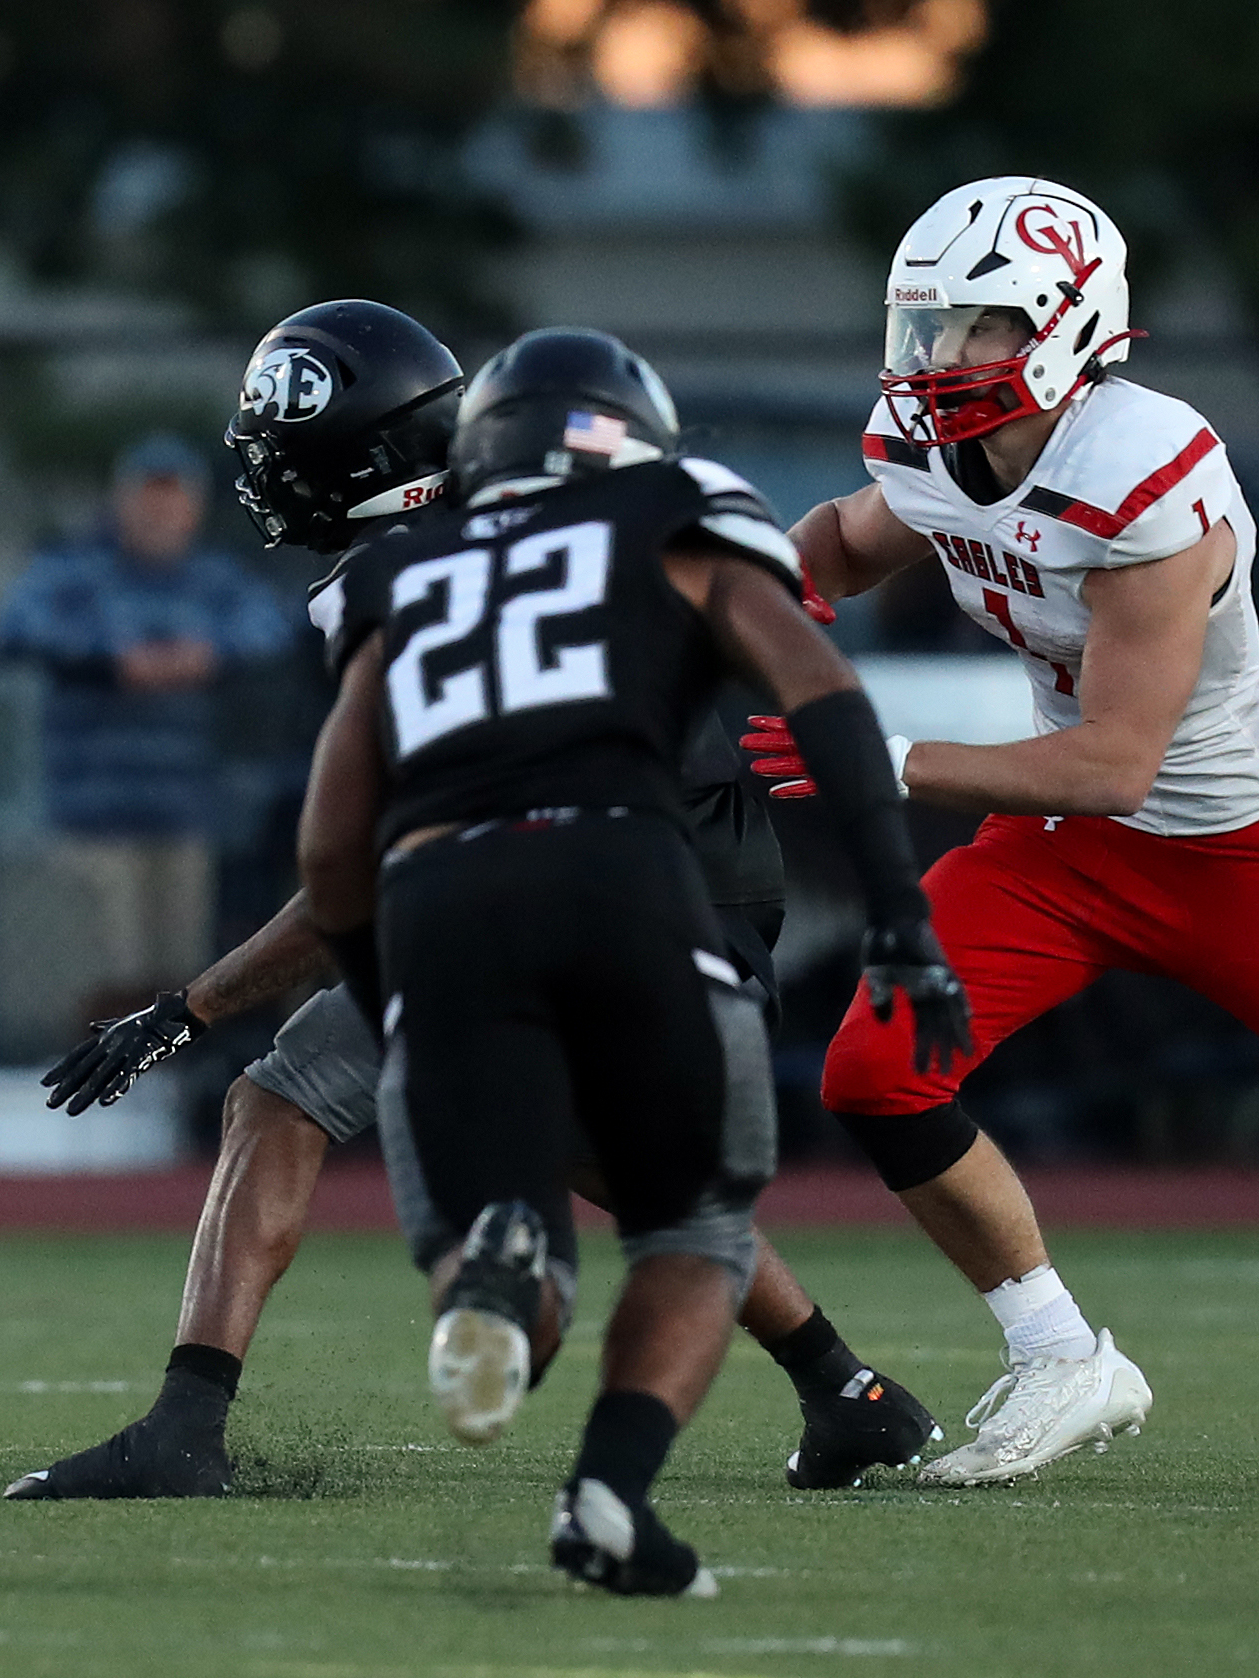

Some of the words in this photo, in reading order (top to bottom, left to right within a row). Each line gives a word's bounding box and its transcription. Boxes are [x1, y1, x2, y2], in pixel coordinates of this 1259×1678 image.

[894, 287, 938, 302] Riddell
[1191, 497, 1210, 536] 1
[932, 531, 1046, 599] EAGLES
[386, 520, 614, 762] 22
